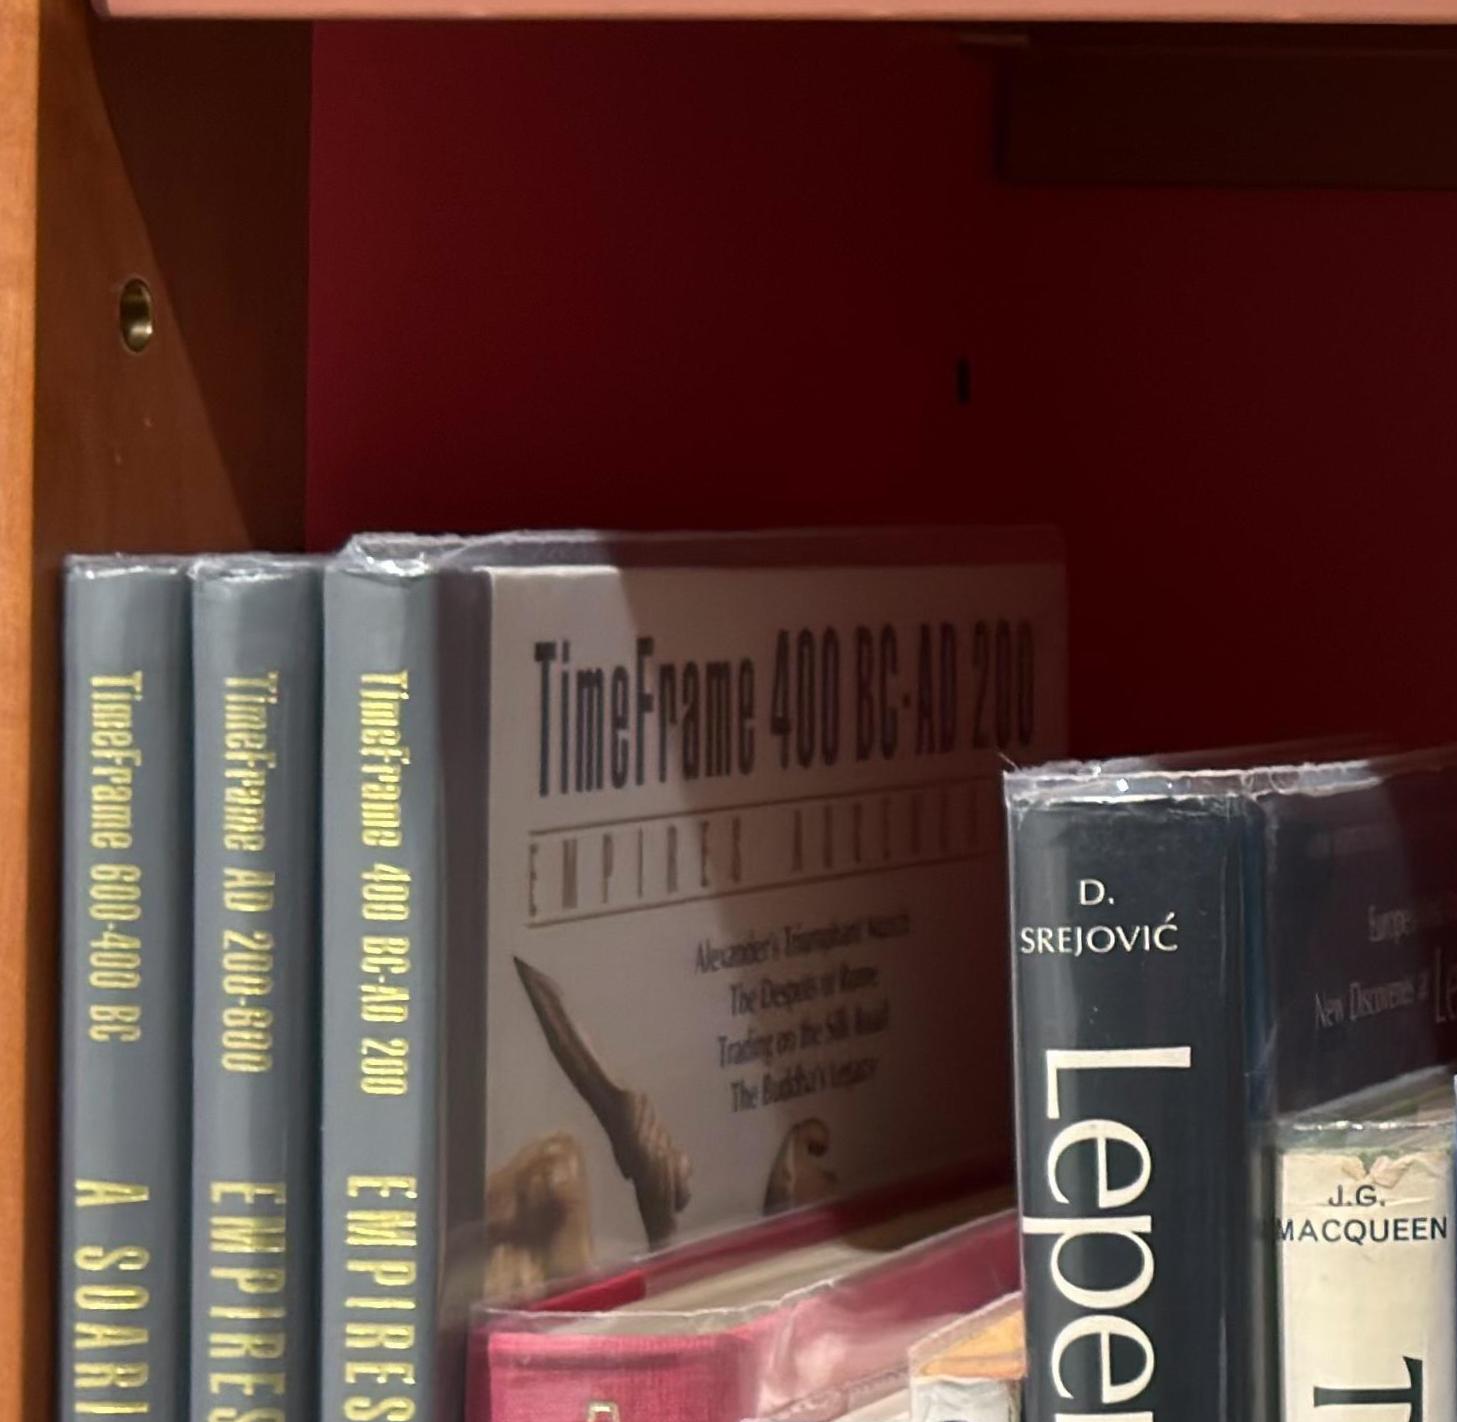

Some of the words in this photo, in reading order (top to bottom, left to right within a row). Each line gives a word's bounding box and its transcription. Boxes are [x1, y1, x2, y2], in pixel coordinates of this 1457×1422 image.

[359, 671, 410, 848] TimeFrame
[360, 863, 412, 922] 400
[1078, 878, 1115, 906] D.
[1020, 912, 1179, 956] SREJOVIĆ
[359, 1037, 410, 1096] 200
[73, 1178, 150, 1208] A
[1276, 1216, 1448, 1244] MACQUEEN
[343, 1174, 418, 1422] EMPIRES
